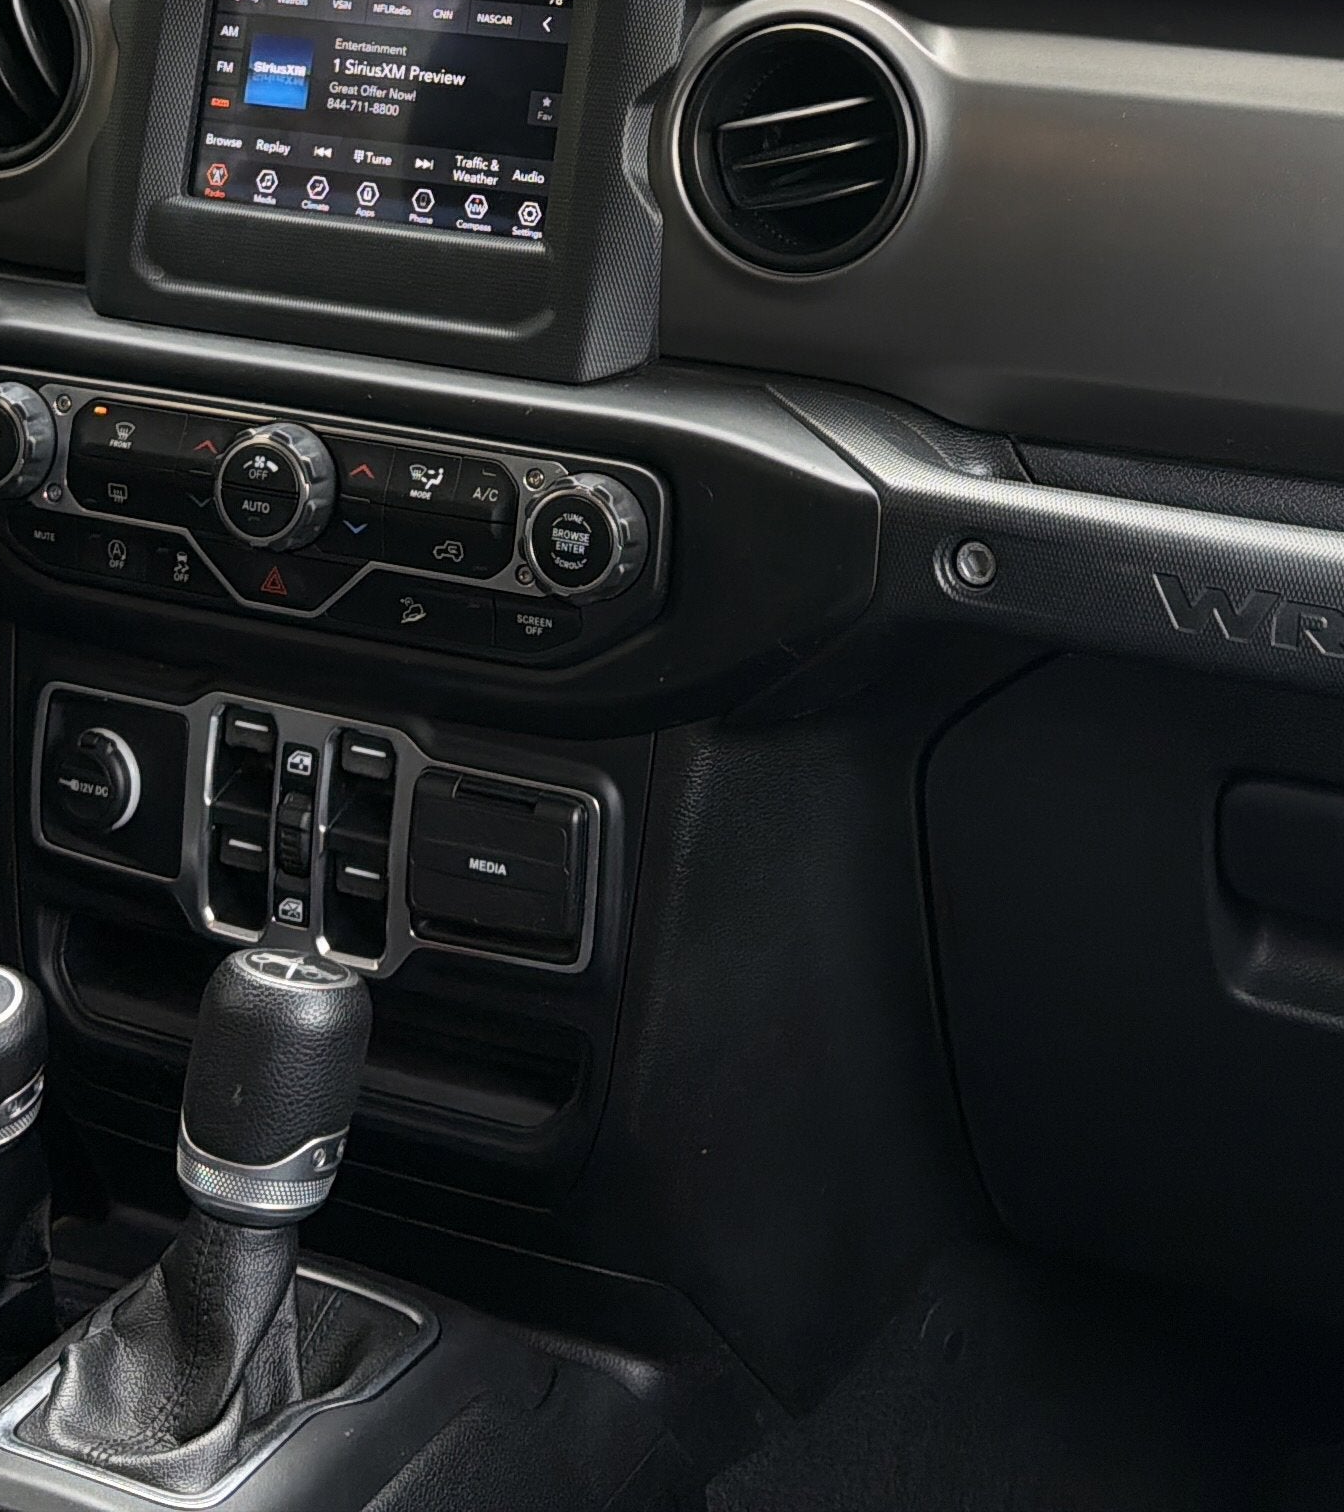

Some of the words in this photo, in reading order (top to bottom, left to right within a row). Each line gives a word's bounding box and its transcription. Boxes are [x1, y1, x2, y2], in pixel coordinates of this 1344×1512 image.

[432, 9, 454, 20] CNN
[477, 13, 513, 26] NASCAR
[220, 25, 239, 37] AM
[335, 37, 408, 56] Entertainment
[217, 61, 234, 74] FM
[254, 61, 307, 76] SiriusXM
[333, 58, 340, 73] 1
[345, 58, 405, 80] SiriusXM
[409, 65, 466, 86] Preview
[329, 81, 358, 95] Great
[360, 85, 386, 99] Offer
[389, 88, 416, 102] Now!
[326, 98, 400, 117] 844-711-8800
[536, 111, 552, 121] Fav
[206, 133, 243, 149] Browse
[256, 139, 291, 157] Replay
[365, 152, 393, 166] Tune
[455, 155, 489, 171] Traffic
[490, 159, 500, 172] &
[453, 169, 498, 186] Weather
[512, 169, 545, 184] Audio
[204, 188, 226, 199] Radio
[253, 194, 277, 205] Media
[301, 200, 330, 212] Climate
[355, 207, 375, 218] Apps
[409, 213, 434, 225] Phone
[456, 220, 492, 233] Compass
[512, 226, 543, 240] Settings
[109, 439, 133, 449] FRONT
[249, 469, 268, 481] OFF
[409, 489, 431, 500] MODE
[472, 486, 499, 502] A/C
[242, 499, 270, 514] AUTO
[563, 513, 584, 524] TUNE
[34, 530, 56, 541] MUTE
[552, 528, 590, 542] BROWSE
[556, 541, 585, 555] ENTER
[109, 560, 124, 569] OFF
[555, 556, 583, 569] SCROLL
[173, 573, 189, 582] OFF
[517, 614, 553, 628] SCREEN
[525, 626, 543, 636] OFF
[80, 782, 94, 794] 12V
[95, 785, 109, 798] DC
[469, 857, 507, 876] MEDIA
